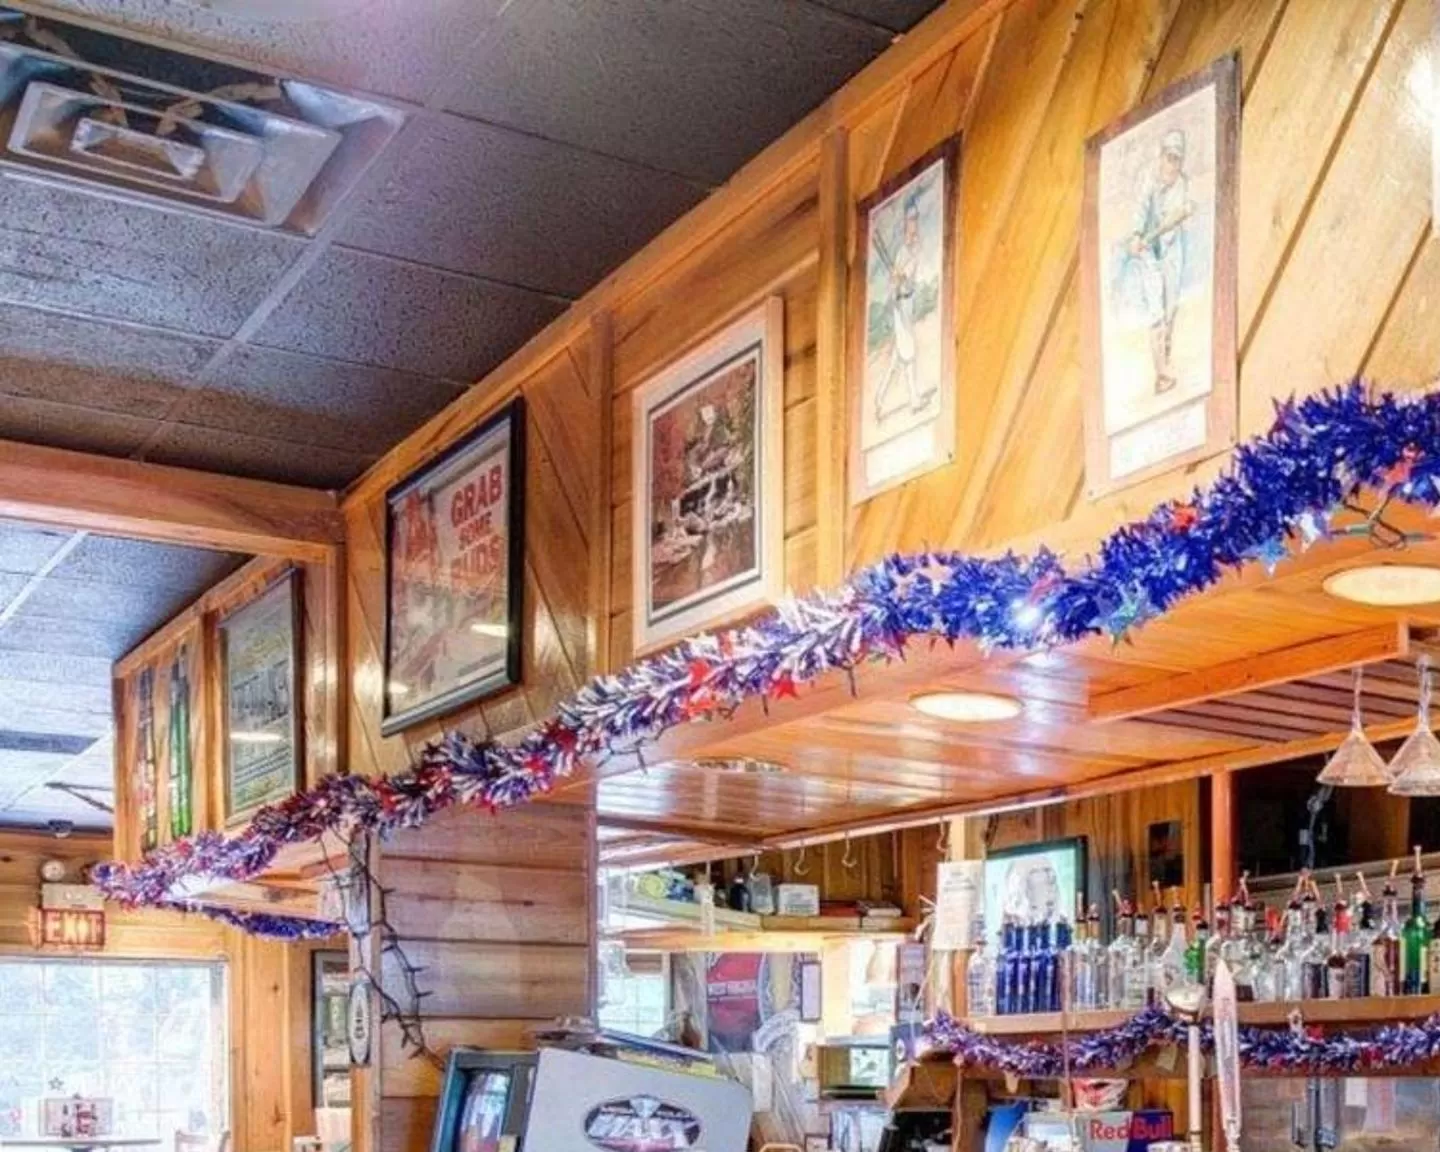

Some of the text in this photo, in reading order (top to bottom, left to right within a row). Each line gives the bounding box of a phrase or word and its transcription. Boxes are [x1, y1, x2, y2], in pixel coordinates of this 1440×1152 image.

[451, 464, 502, 528] GRAB
[459, 511, 492, 550] SOME
[46, 911, 101, 944] EXIT
[1090, 1115, 1173, 1141] Red Bull
